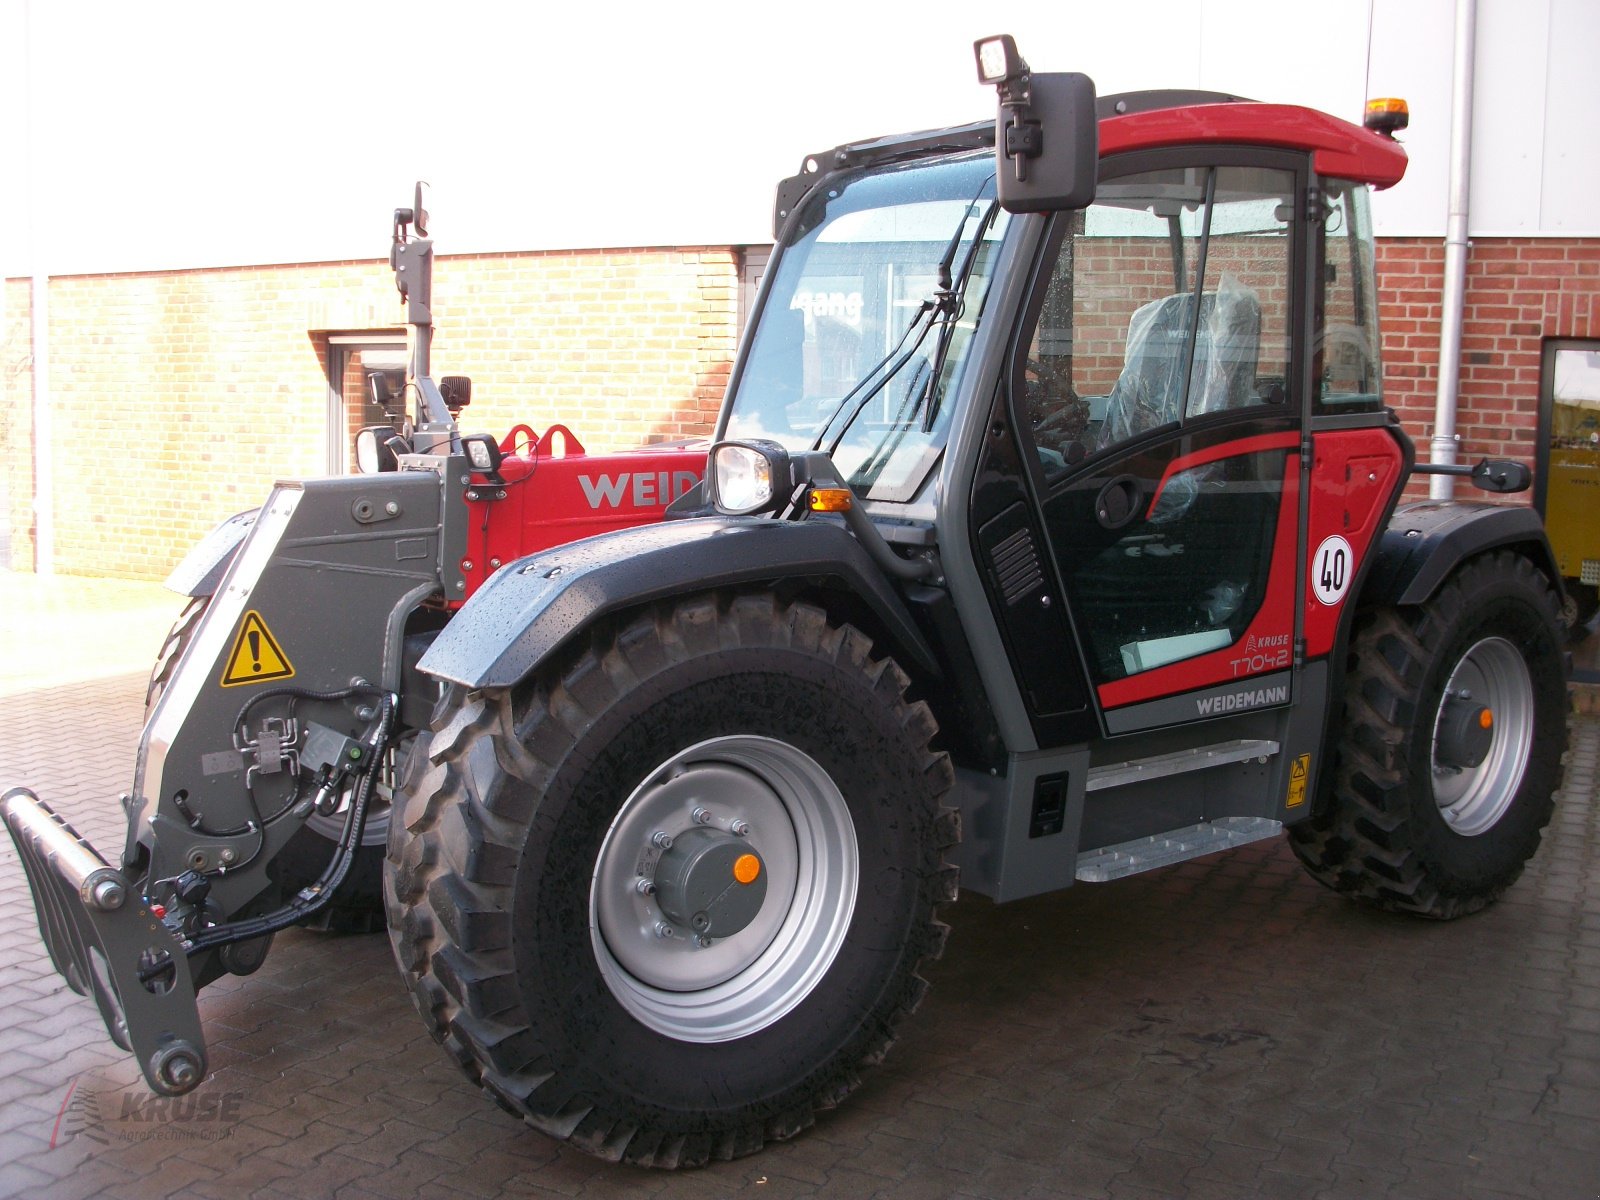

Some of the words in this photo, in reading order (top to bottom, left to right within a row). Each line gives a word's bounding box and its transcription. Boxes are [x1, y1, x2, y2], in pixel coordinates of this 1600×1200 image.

[577, 471, 706, 509] WEID
[1320, 548, 1345, 592] 40
[1257, 634, 1289, 648] KRUSE
[1230, 649, 1288, 676] T7042
[1196, 686, 1287, 715] WEIDEMANN
